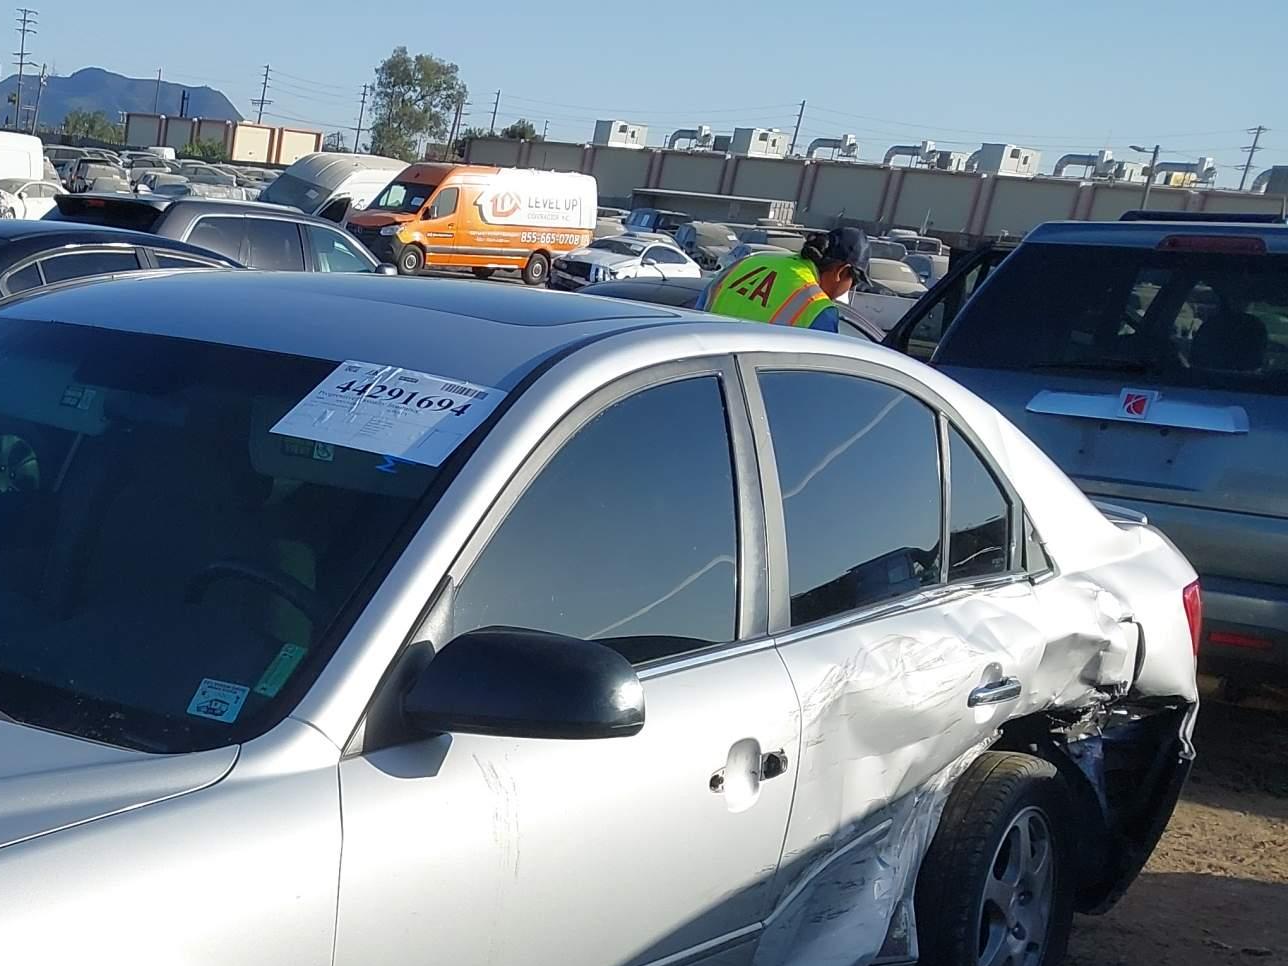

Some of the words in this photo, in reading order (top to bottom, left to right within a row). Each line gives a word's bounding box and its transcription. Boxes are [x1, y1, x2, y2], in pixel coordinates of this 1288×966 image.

[528, 196, 560, 210] LEVEL
[564, 198, 578, 212] UP
[521, 232, 580, 245] 855-665-0708
[335, 379, 473, 417] 44291694
